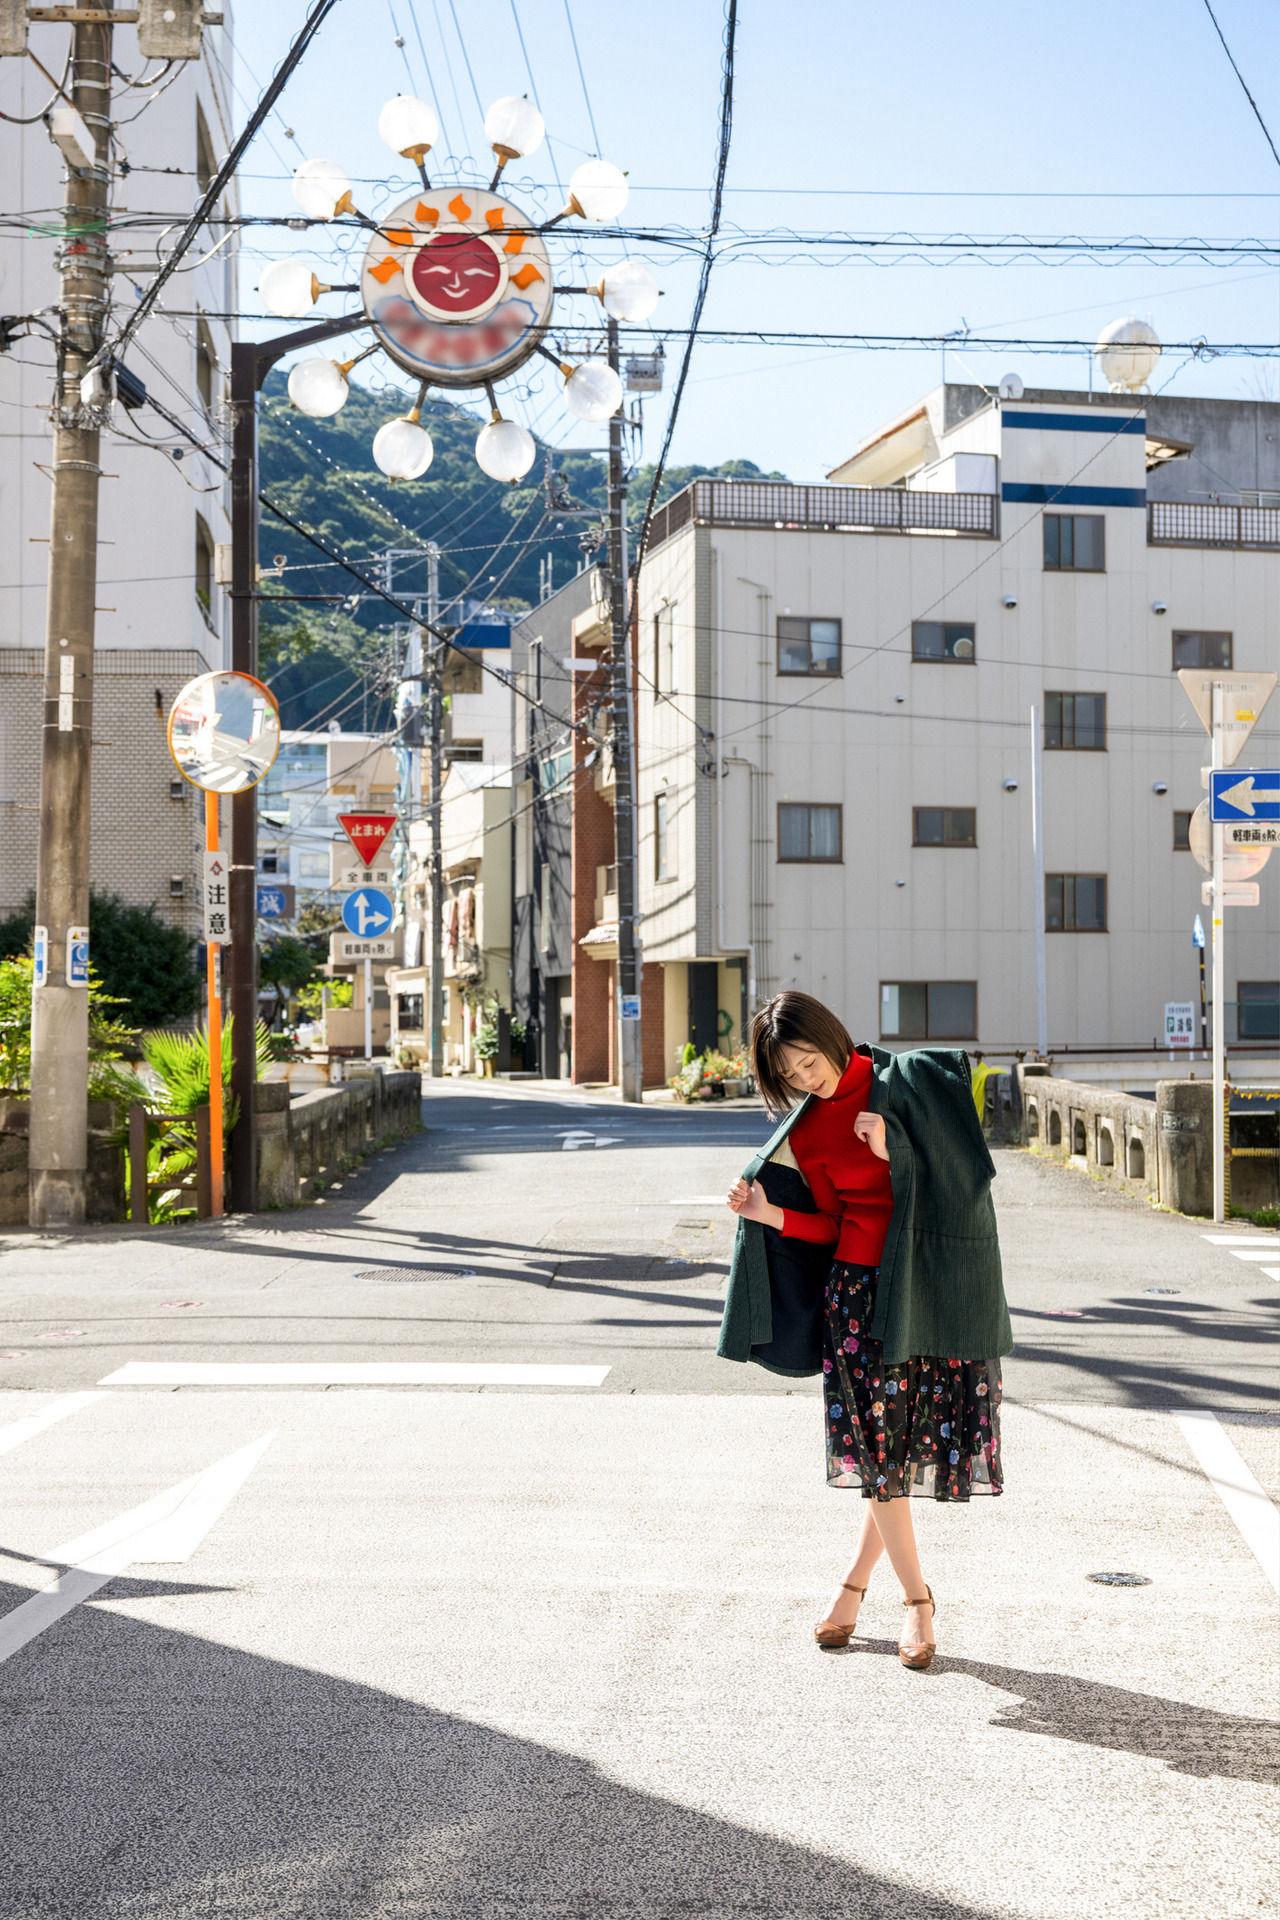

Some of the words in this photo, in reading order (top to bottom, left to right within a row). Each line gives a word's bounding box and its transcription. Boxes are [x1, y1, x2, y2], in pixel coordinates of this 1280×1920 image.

[351, 824, 386, 836] 止まれ
[348, 872, 388, 882] 全車両
[208, 884, 227, 934] 注意
